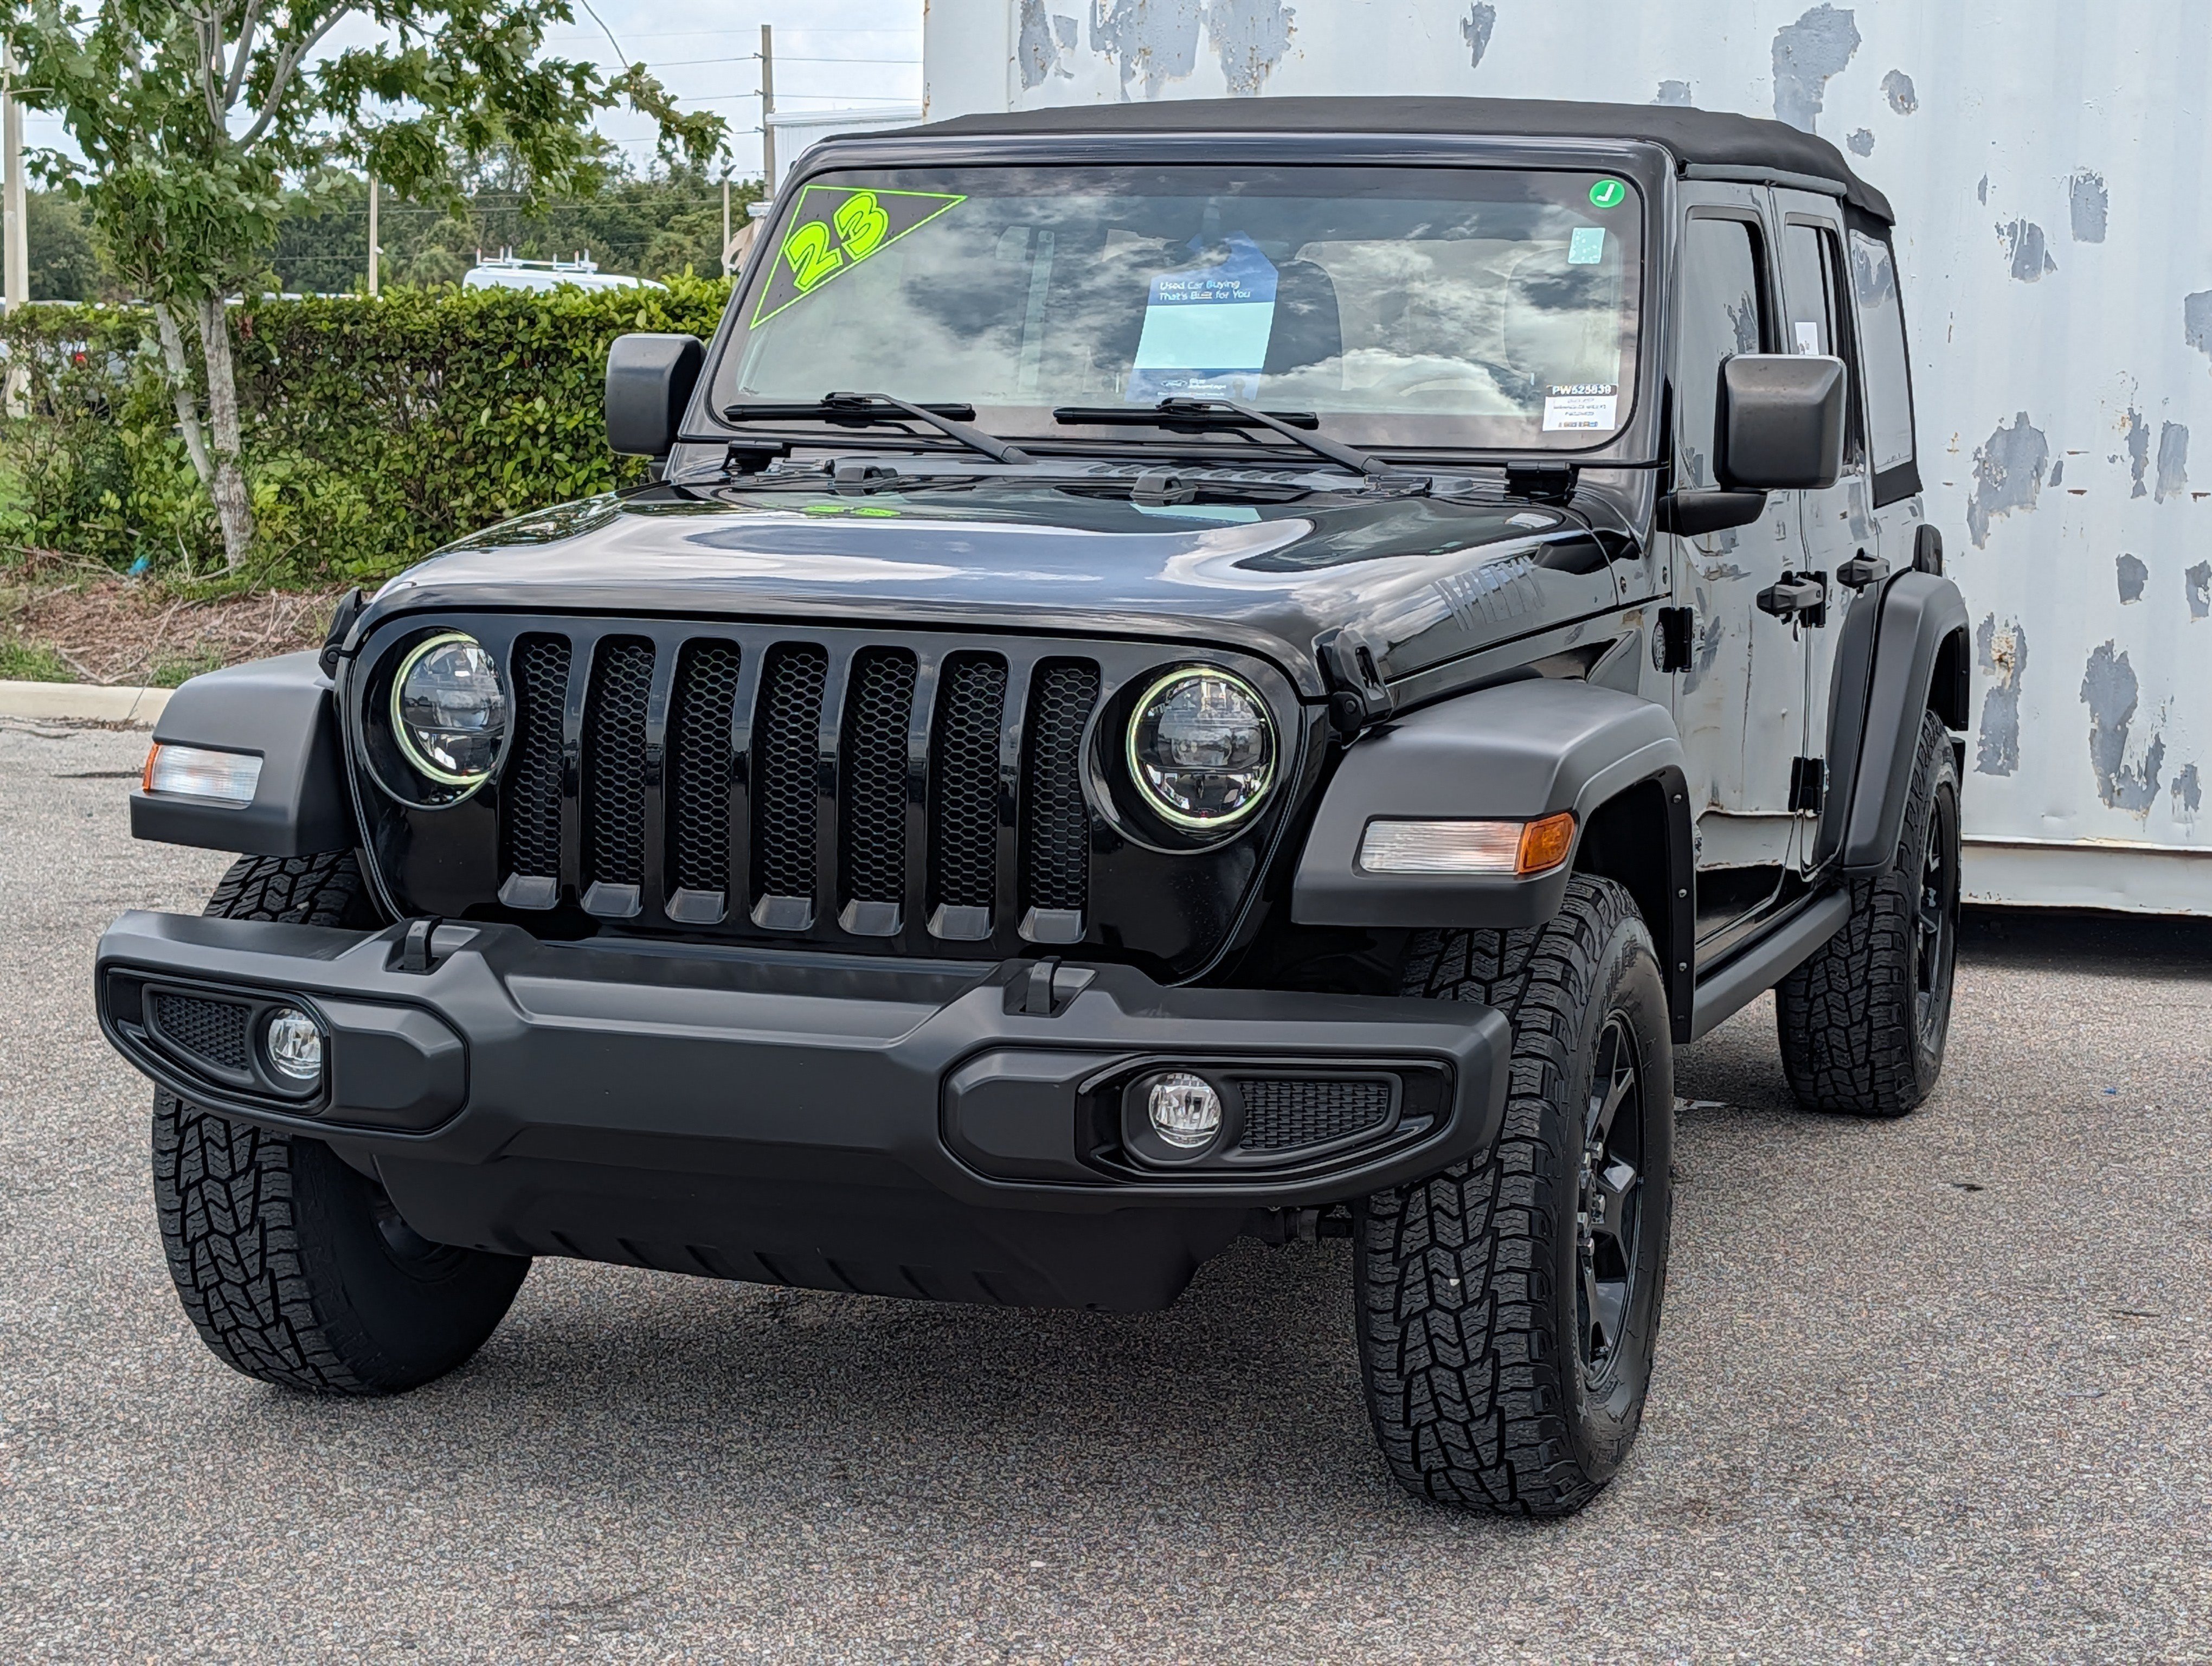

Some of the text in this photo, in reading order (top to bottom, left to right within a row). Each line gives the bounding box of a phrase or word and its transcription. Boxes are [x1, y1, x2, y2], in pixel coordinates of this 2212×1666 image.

[783, 191, 889, 292] 23
[1159, 280, 1240, 290] Used Car Buying
[1159, 292, 1188, 300] That's
[1216, 290, 1229, 299] for
[1232, 289, 1251, 298] You
